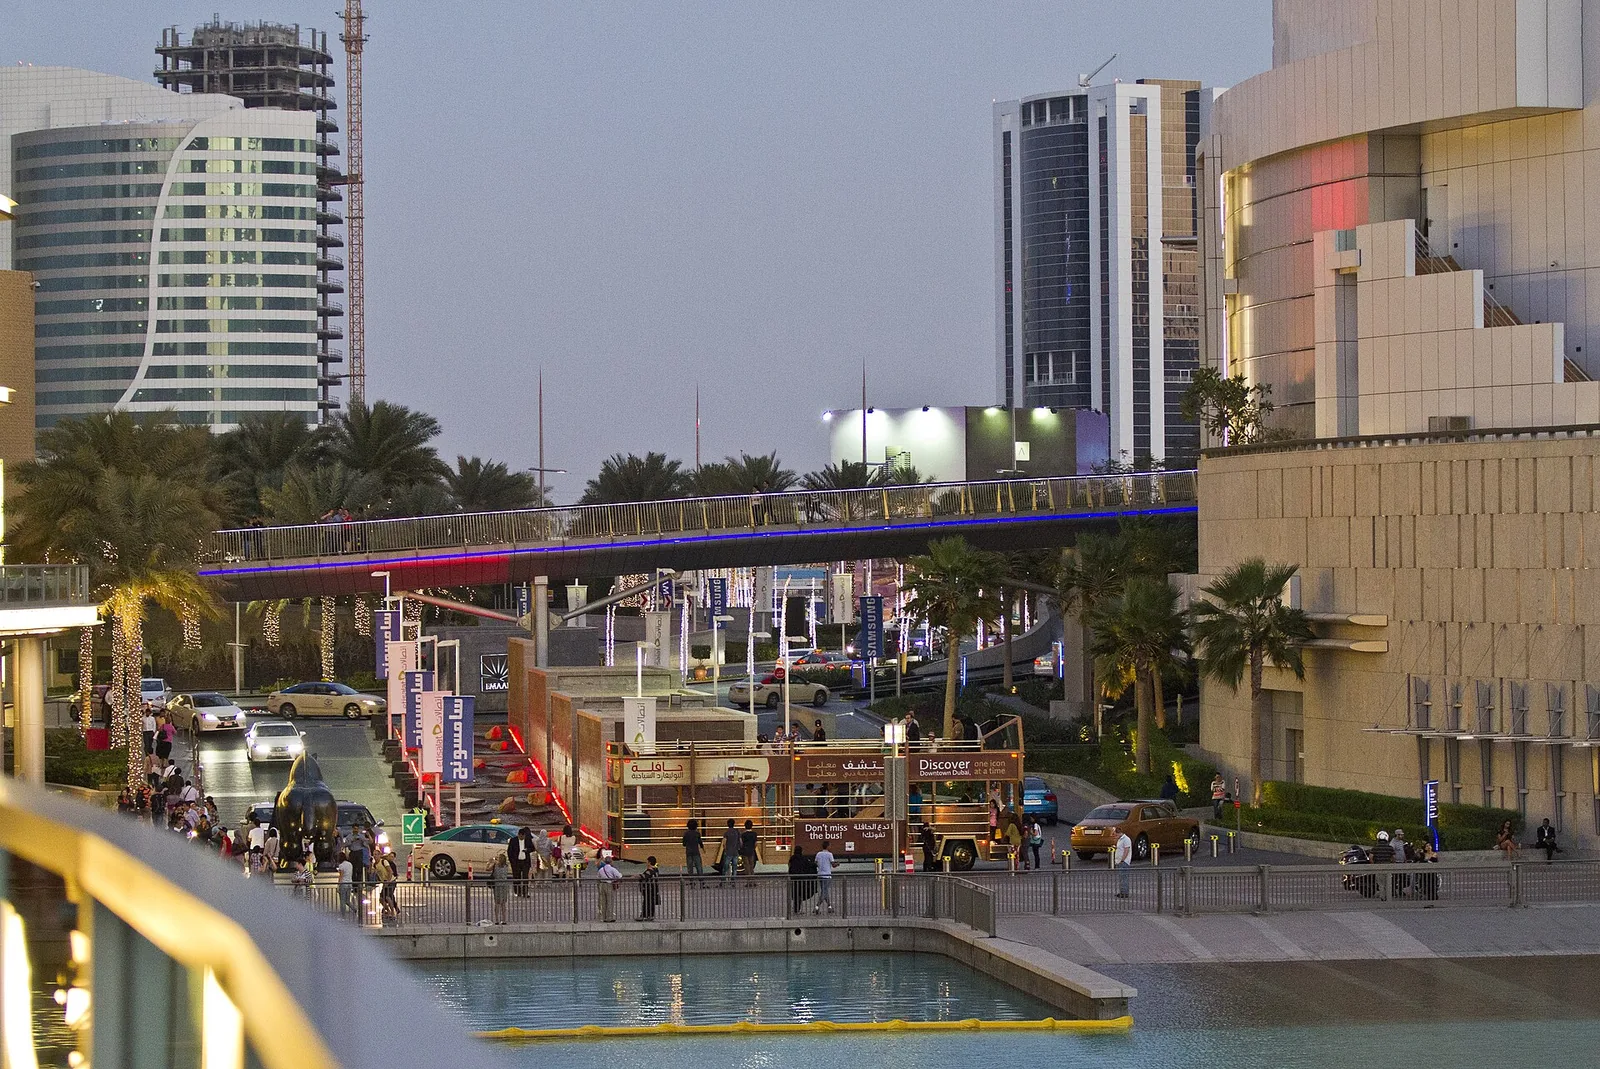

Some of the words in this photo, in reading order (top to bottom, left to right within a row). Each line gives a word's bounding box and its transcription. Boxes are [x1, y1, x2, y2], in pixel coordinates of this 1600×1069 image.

[713, 579, 722, 628] SMSUNG
[866, 597, 876, 657] SAMSUNG
[485, 682, 509, 690] EMAA
[448, 698, 468, 779] سامسونج
[631, 761, 683, 772] حافلة
[920, 759, 970, 770] Discover
[989, 767, 1006, 775] time
[805, 824, 828, 832] Don't
[829, 823, 848, 832] miss
[810, 832, 824, 840] the
[825, 832, 843, 840] bus!
